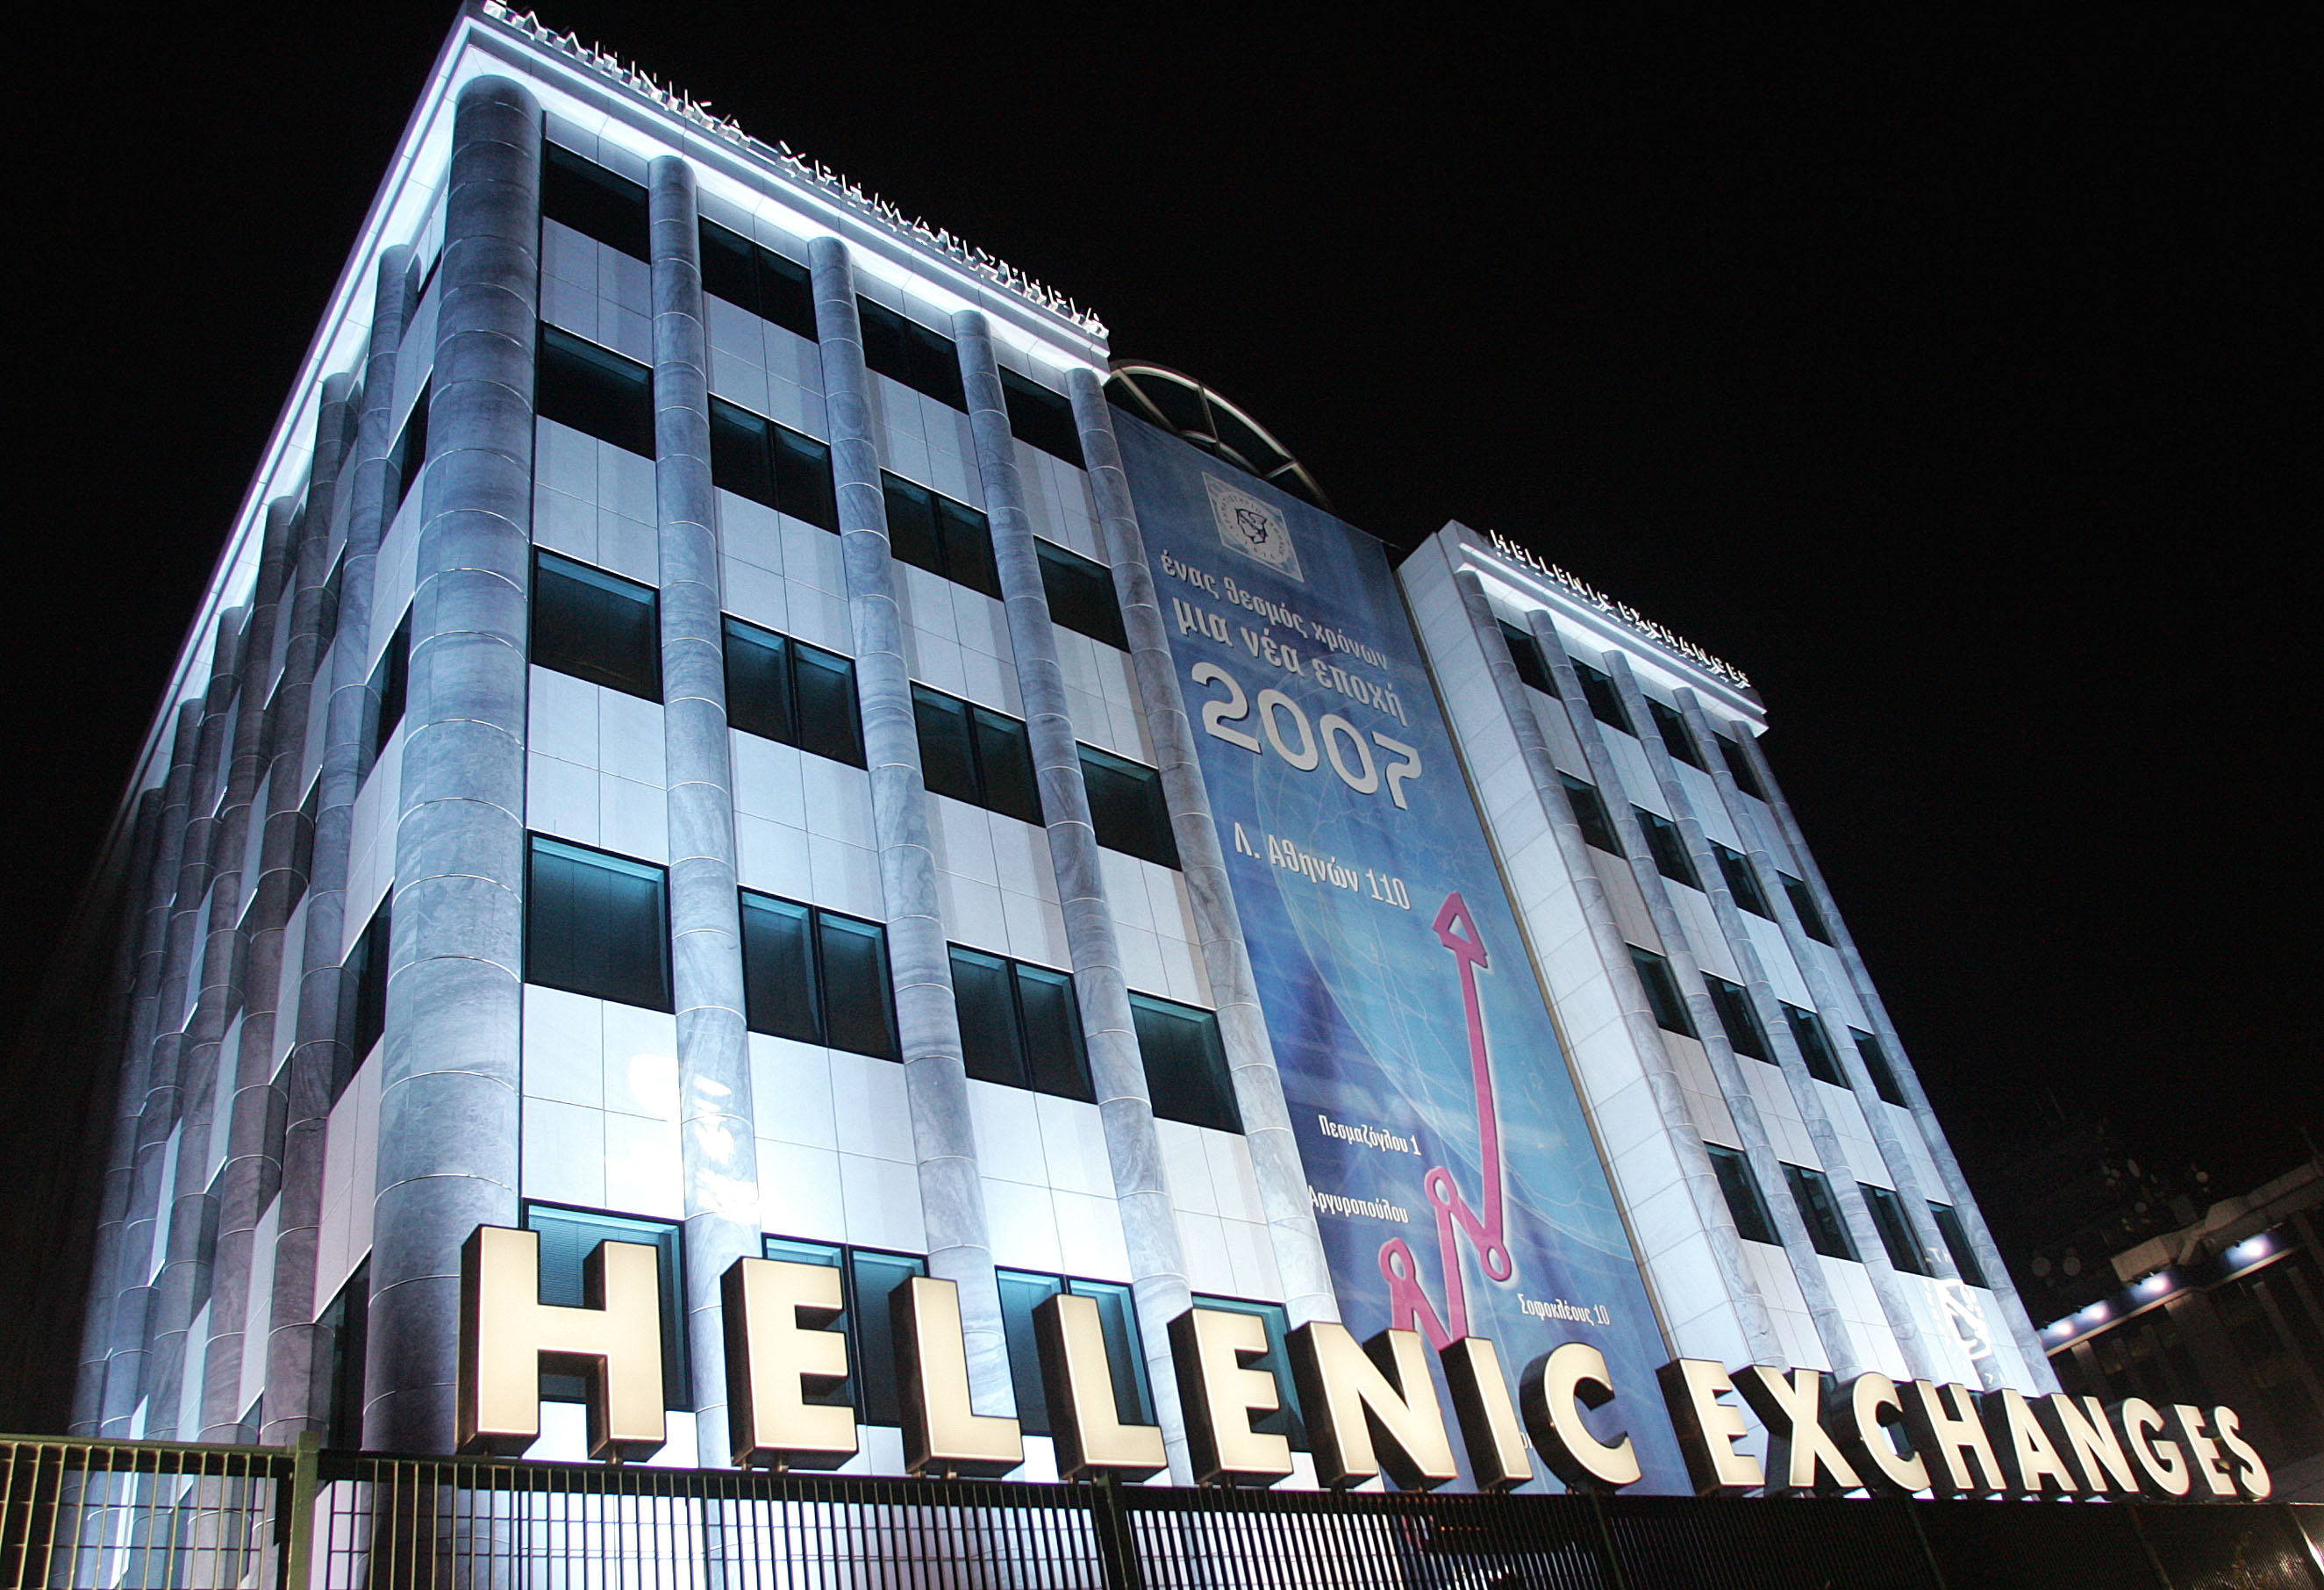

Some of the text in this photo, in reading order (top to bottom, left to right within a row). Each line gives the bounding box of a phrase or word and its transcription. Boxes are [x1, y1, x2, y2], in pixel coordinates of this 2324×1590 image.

[1161, 549, 1388, 670] ένας θεσμός χρόνων
[1172, 597, 1408, 727] μια νέα εποχή
[1490, 529, 1751, 689] HELLENIC EXCHANGES
[1191, 662, 1423, 810] 2007
[1234, 821, 1412, 911] Λ. Αθηνών 110
[1318, 1114, 1422, 1156] Πεσμαζόγλου 1
[1308, 1185, 1410, 1224] Αργυροπούλου
[465, 1225, 2272, 1500] HELLENIC EXCHANGES
[1517, 1293, 1611, 1326] Σοφοκλέους 10
